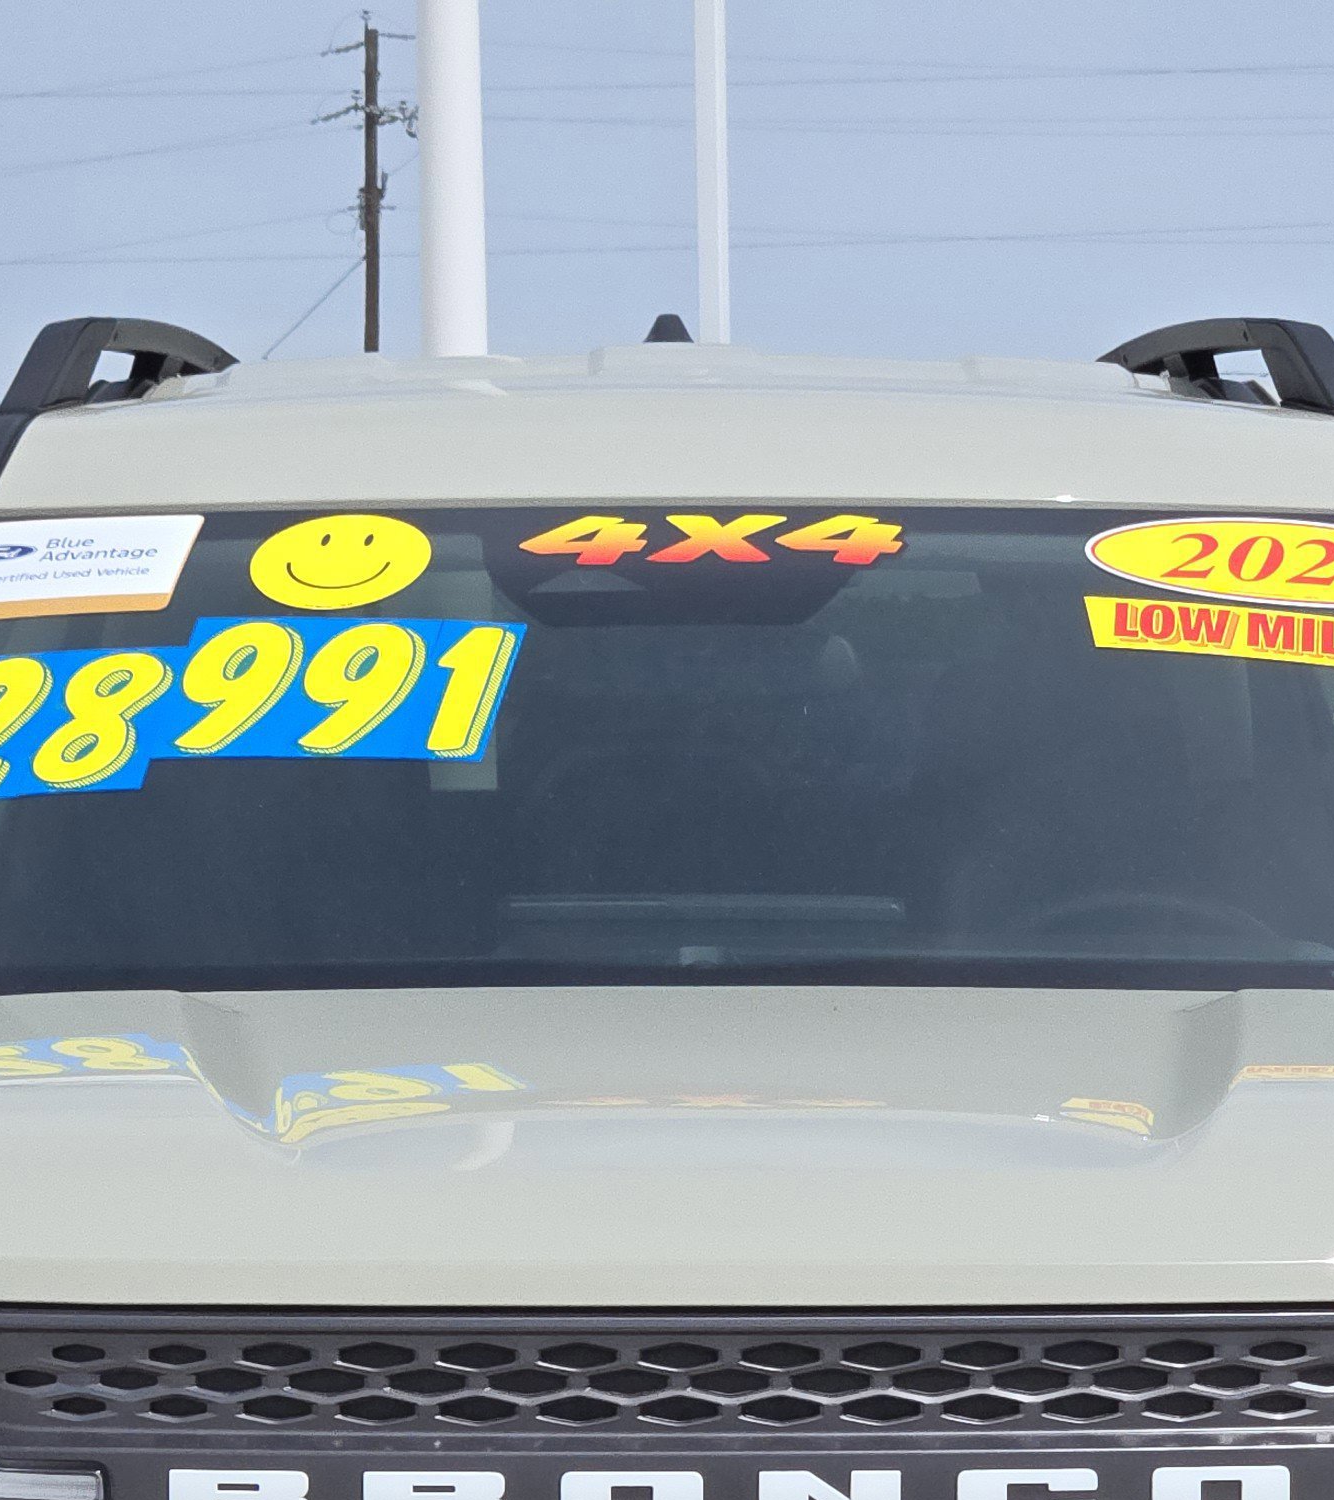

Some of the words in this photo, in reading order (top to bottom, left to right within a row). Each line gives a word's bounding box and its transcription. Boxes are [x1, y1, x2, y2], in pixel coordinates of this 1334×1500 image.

[45, 537, 95, 549] Blue
[38, 547, 158, 562] Advantage
[52, 568, 91, 580] Used
[97, 565, 150, 577] Vehicle
[1113, 602, 1238, 650] LOW
